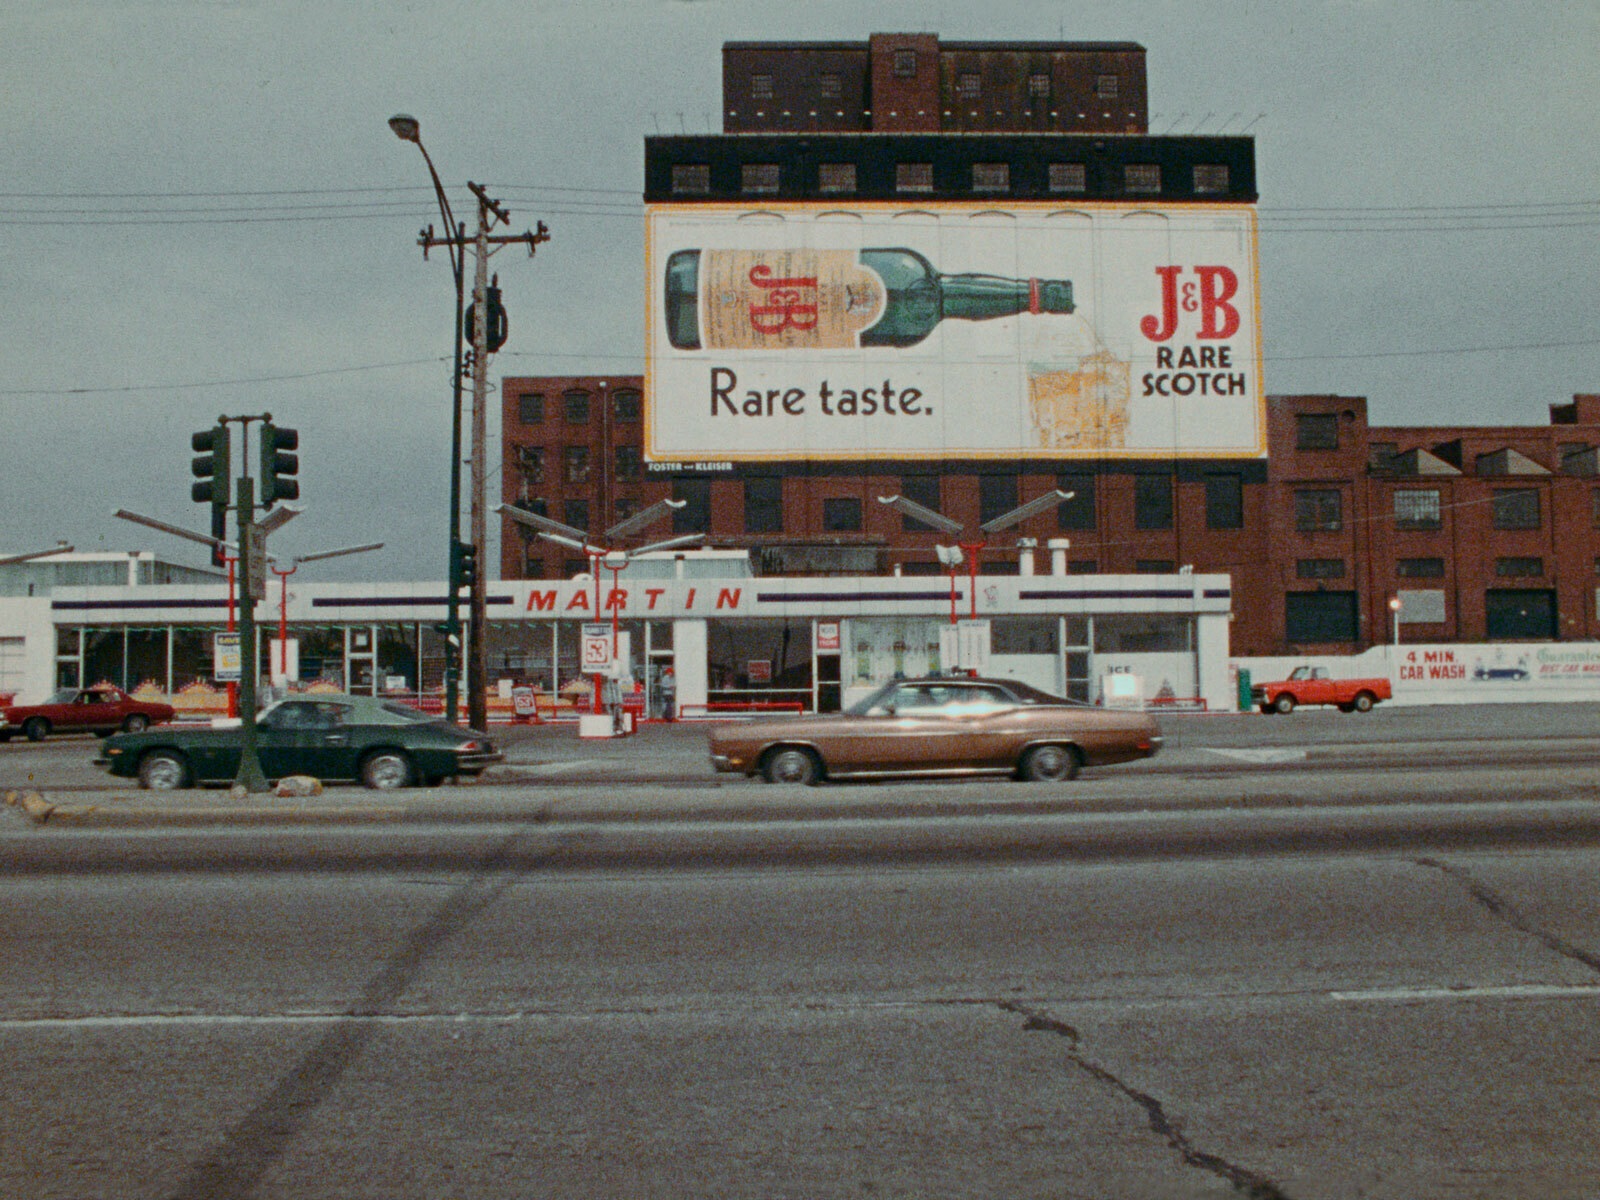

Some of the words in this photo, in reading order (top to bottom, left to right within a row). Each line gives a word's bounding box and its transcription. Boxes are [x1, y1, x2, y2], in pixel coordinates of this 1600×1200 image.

[749, 265, 818, 335] J&B
[1140, 265, 1241, 342] J&B
[1156, 346, 1232, 369] RARE
[710, 367, 806, 417] Rare
[819, 379, 934, 417] taste.
[1142, 372, 1245, 397] SCOTCH
[648, 462, 682, 471] FOSTER
[695, 462, 732, 471] KLEISER
[526, 588, 742, 612] MARTIN
[1406, 651, 1416, 663] 4
[1400, 665, 1424, 680] CAR
[1429, 665, 1466, 680] WASH
